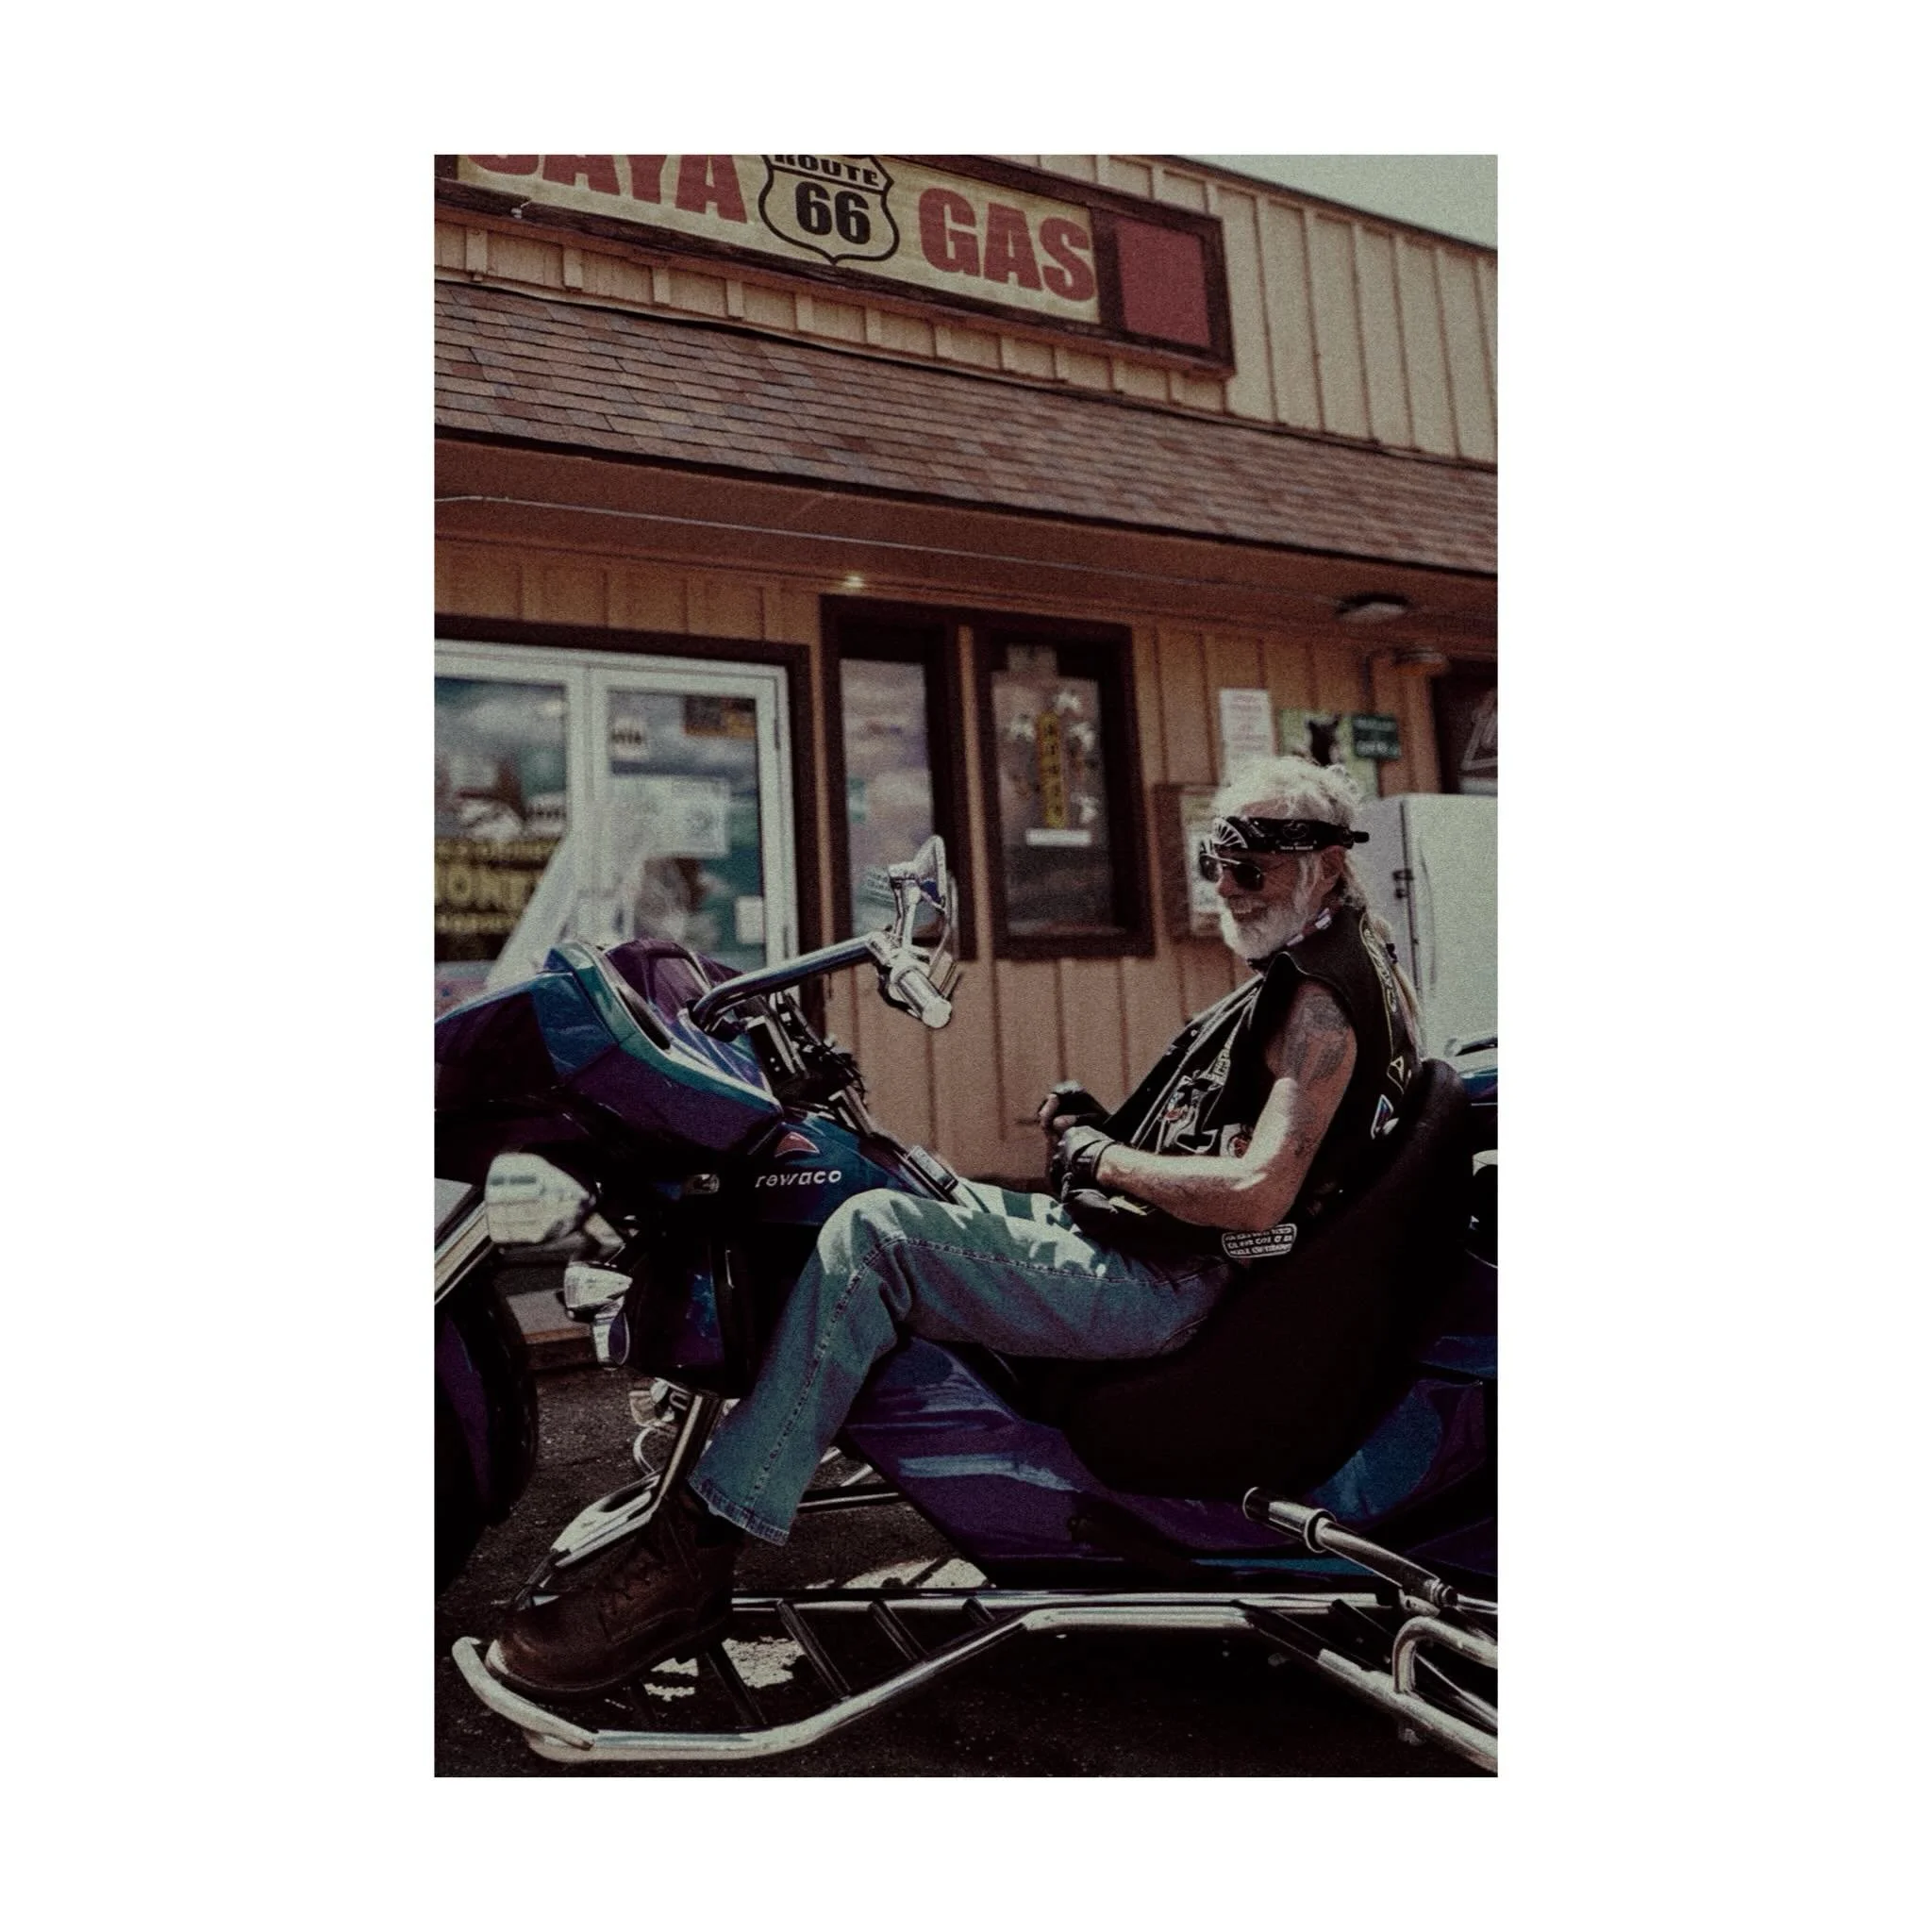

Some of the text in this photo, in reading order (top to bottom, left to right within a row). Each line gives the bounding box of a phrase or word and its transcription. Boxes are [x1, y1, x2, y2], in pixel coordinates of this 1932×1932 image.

[468, 155, 748, 223] AYA
[794, 180, 871, 244] 66
[918, 190, 1097, 301] GAS
[755, 1169, 842, 1190] rewaco
